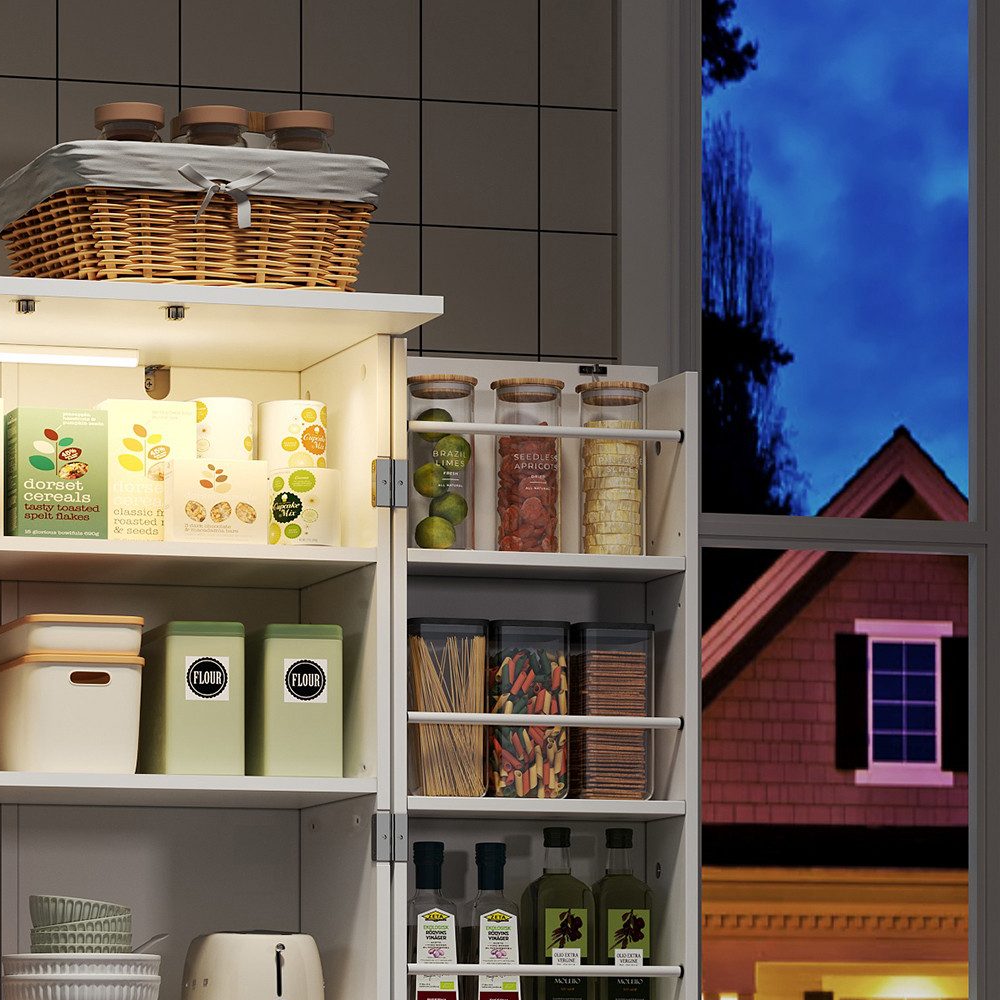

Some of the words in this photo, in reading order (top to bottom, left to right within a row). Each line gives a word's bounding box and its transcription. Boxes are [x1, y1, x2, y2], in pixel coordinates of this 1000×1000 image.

[432, 450, 466, 458] BRAZIL
[514, 453, 558, 461] SEEDLESS
[435, 459, 465, 468] LIMES
[23, 478, 84, 491] dorset
[23, 492, 91, 503] cereals
[24, 503, 54, 512] tasty
[57, 504, 101, 513] toasted
[273, 502, 300, 512] Cupcake
[24, 512, 53, 521] spelt
[55, 512, 90, 521] flakes
[113, 508, 154, 517] classic
[281, 508, 296, 517] Mix
[113, 517, 158, 526] roasted
[113, 526, 124, 535] &
[126, 527, 159, 535] seeds
[193, 670, 222, 685] FLOUR
[291, 673, 321, 687] FLOUR
